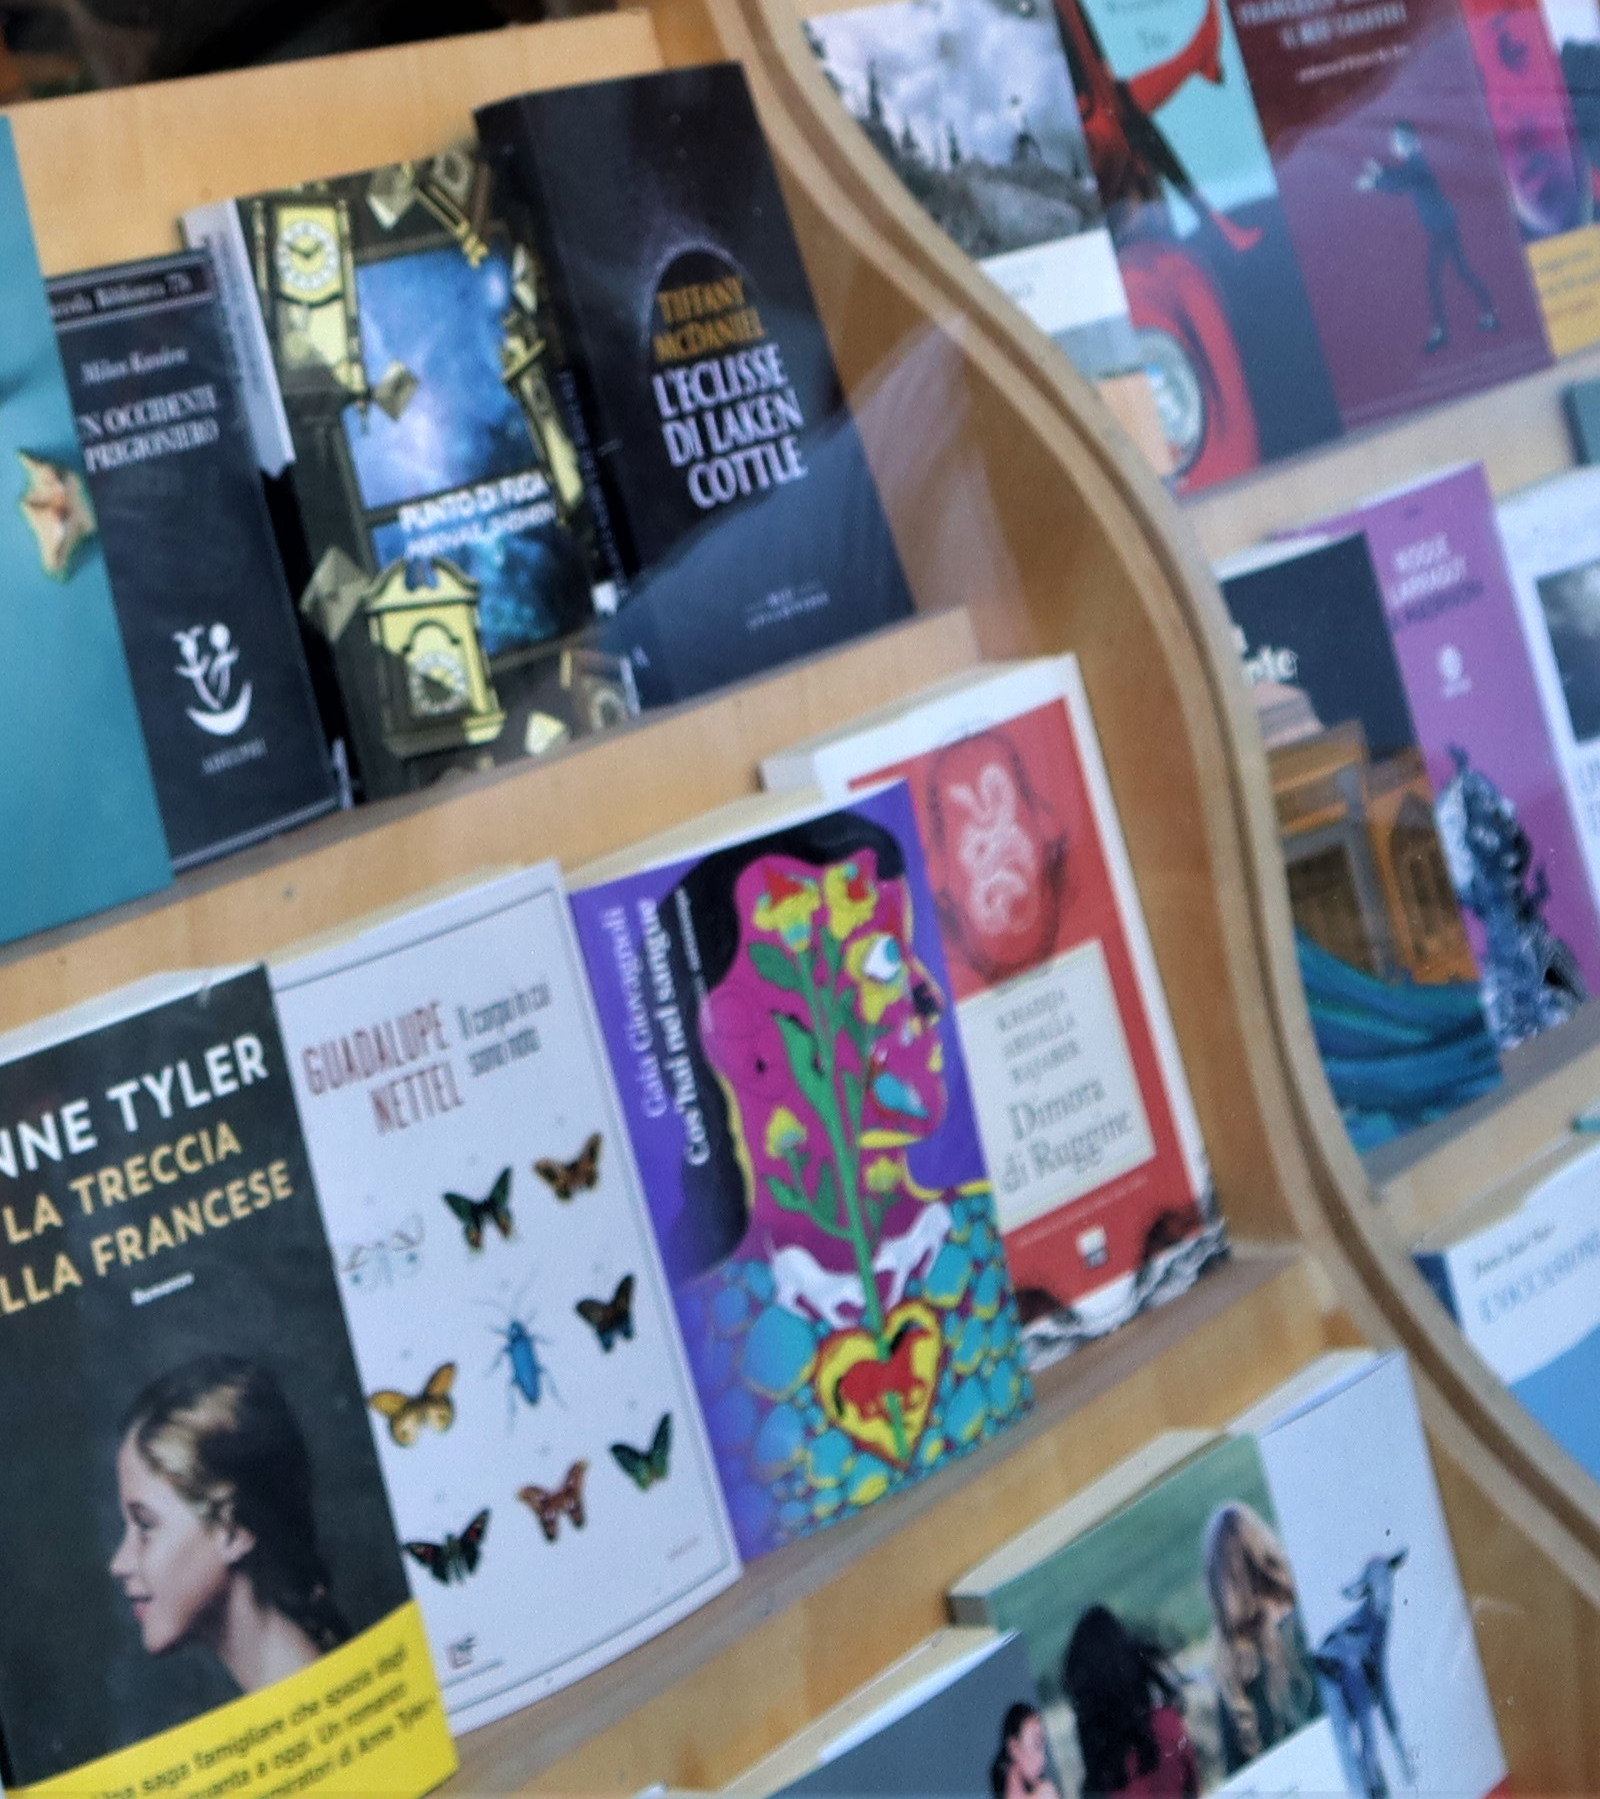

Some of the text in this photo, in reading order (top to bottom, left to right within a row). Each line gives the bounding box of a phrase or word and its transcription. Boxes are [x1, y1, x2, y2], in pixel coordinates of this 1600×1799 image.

[653, 343, 786, 421] L'ECLISSE
[663, 390, 804, 468] DI LAKEN
[687, 443, 808, 509] COTTLE
[106, 1033, 269, 1133] TYLER
[300, 1000, 450, 1097] GUADALUPE
[370, 1059, 465, 1136] NETTEL
[1, 1120, 243, 1246] LA TRECCIA
[90, 1159, 295, 1278] FRANCESE
